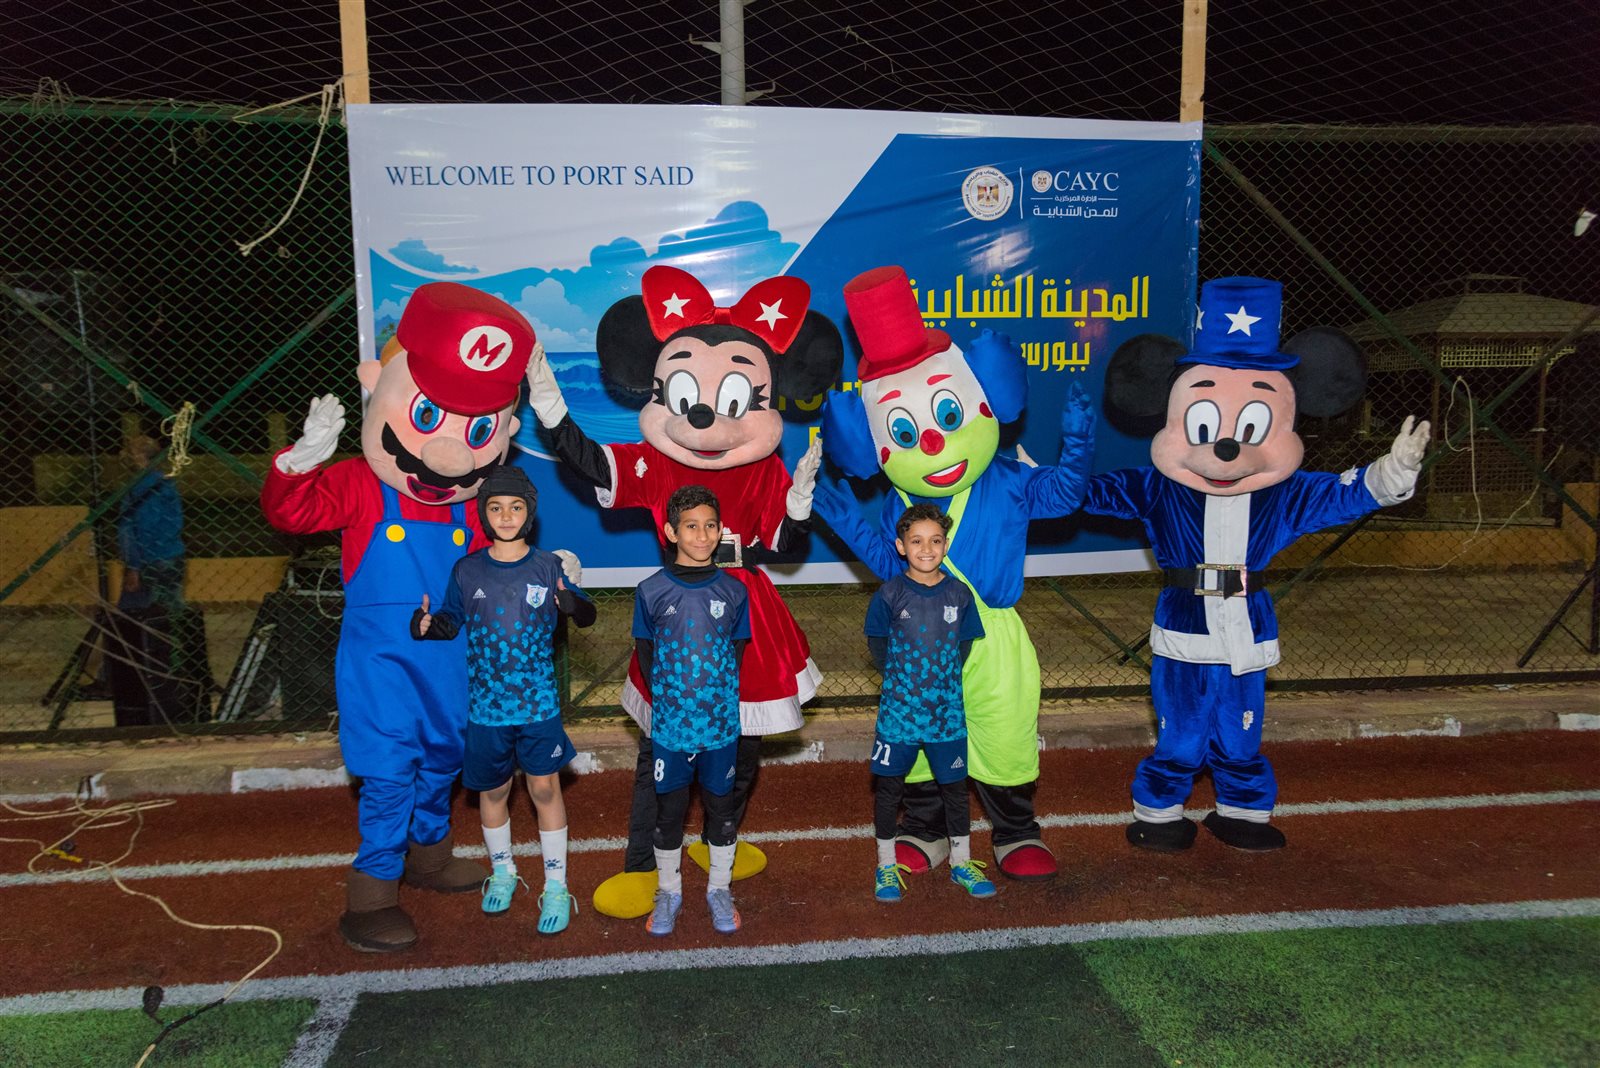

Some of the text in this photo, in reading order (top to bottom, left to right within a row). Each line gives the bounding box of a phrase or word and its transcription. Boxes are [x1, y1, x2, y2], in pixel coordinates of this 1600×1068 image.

[385, 165, 694, 186] WELCOME TO PORT SAID
[1053, 170, 1120, 192] CAYC
[1054, 195, 1080, 203] المركزية
[1032, 205, 1119, 219] للمدن الشبابية
[1041, 275, 1150, 327] المدينة
[466, 333, 507, 368] M
[653, 758, 665, 782] 8
